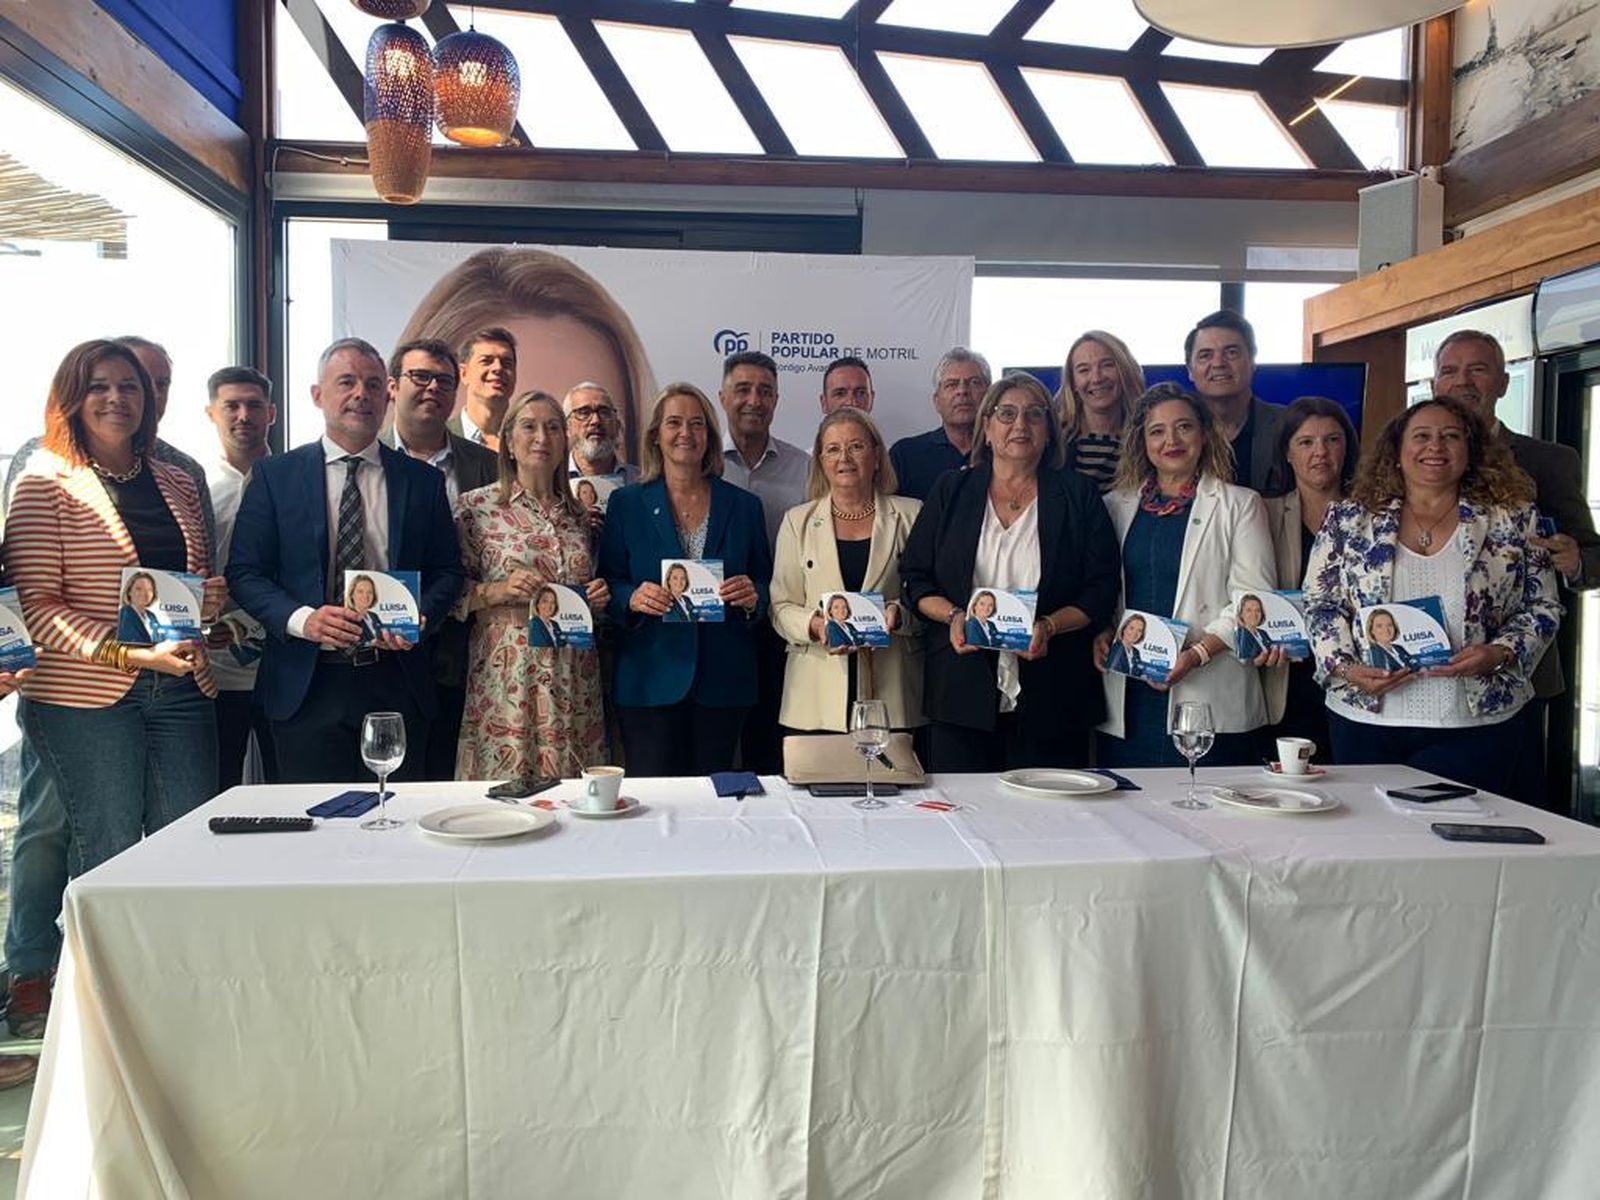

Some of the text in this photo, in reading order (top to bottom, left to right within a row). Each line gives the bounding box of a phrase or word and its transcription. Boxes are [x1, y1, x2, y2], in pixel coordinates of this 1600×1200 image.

[771, 332, 834, 345] PARTIDO
[771, 346, 918, 360] POPULAR DE MOTRIL
[159, 603, 189, 613] LUISA
[379, 603, 408, 612] LUISA
[560, 612, 584, 621] LUISA
[997, 615, 1023, 623] LUISA
[1268, 620, 1296, 629] LUISA
[1403, 630, 1435, 643] LUISA
[1143, 642, 1169, 655] LUISA
